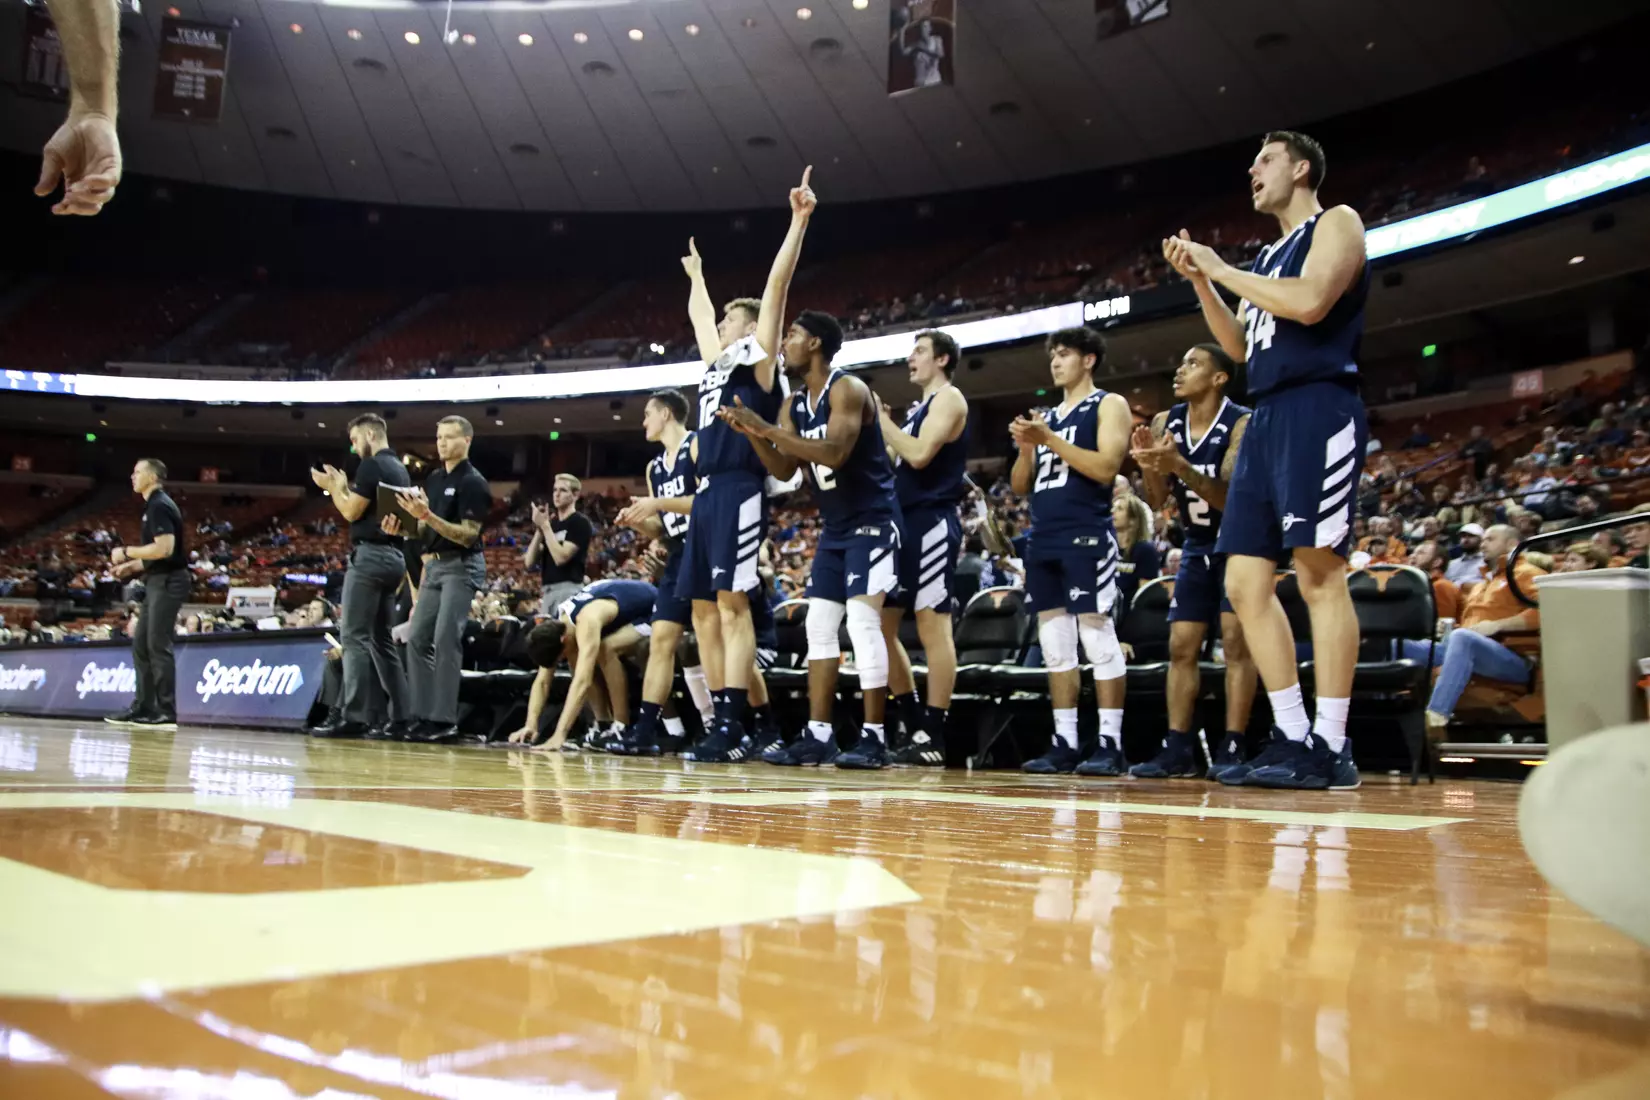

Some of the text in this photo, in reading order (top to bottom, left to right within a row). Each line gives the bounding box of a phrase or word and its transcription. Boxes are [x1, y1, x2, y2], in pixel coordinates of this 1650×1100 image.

[176, 27, 216, 42] TEXAS
[657, 475, 685, 499] CBU
[1034, 452, 1069, 493] 23
[1185, 490, 1211, 527] 2
[76, 661, 137, 700] Spectru
[196, 658, 303, 704] Spectrum
